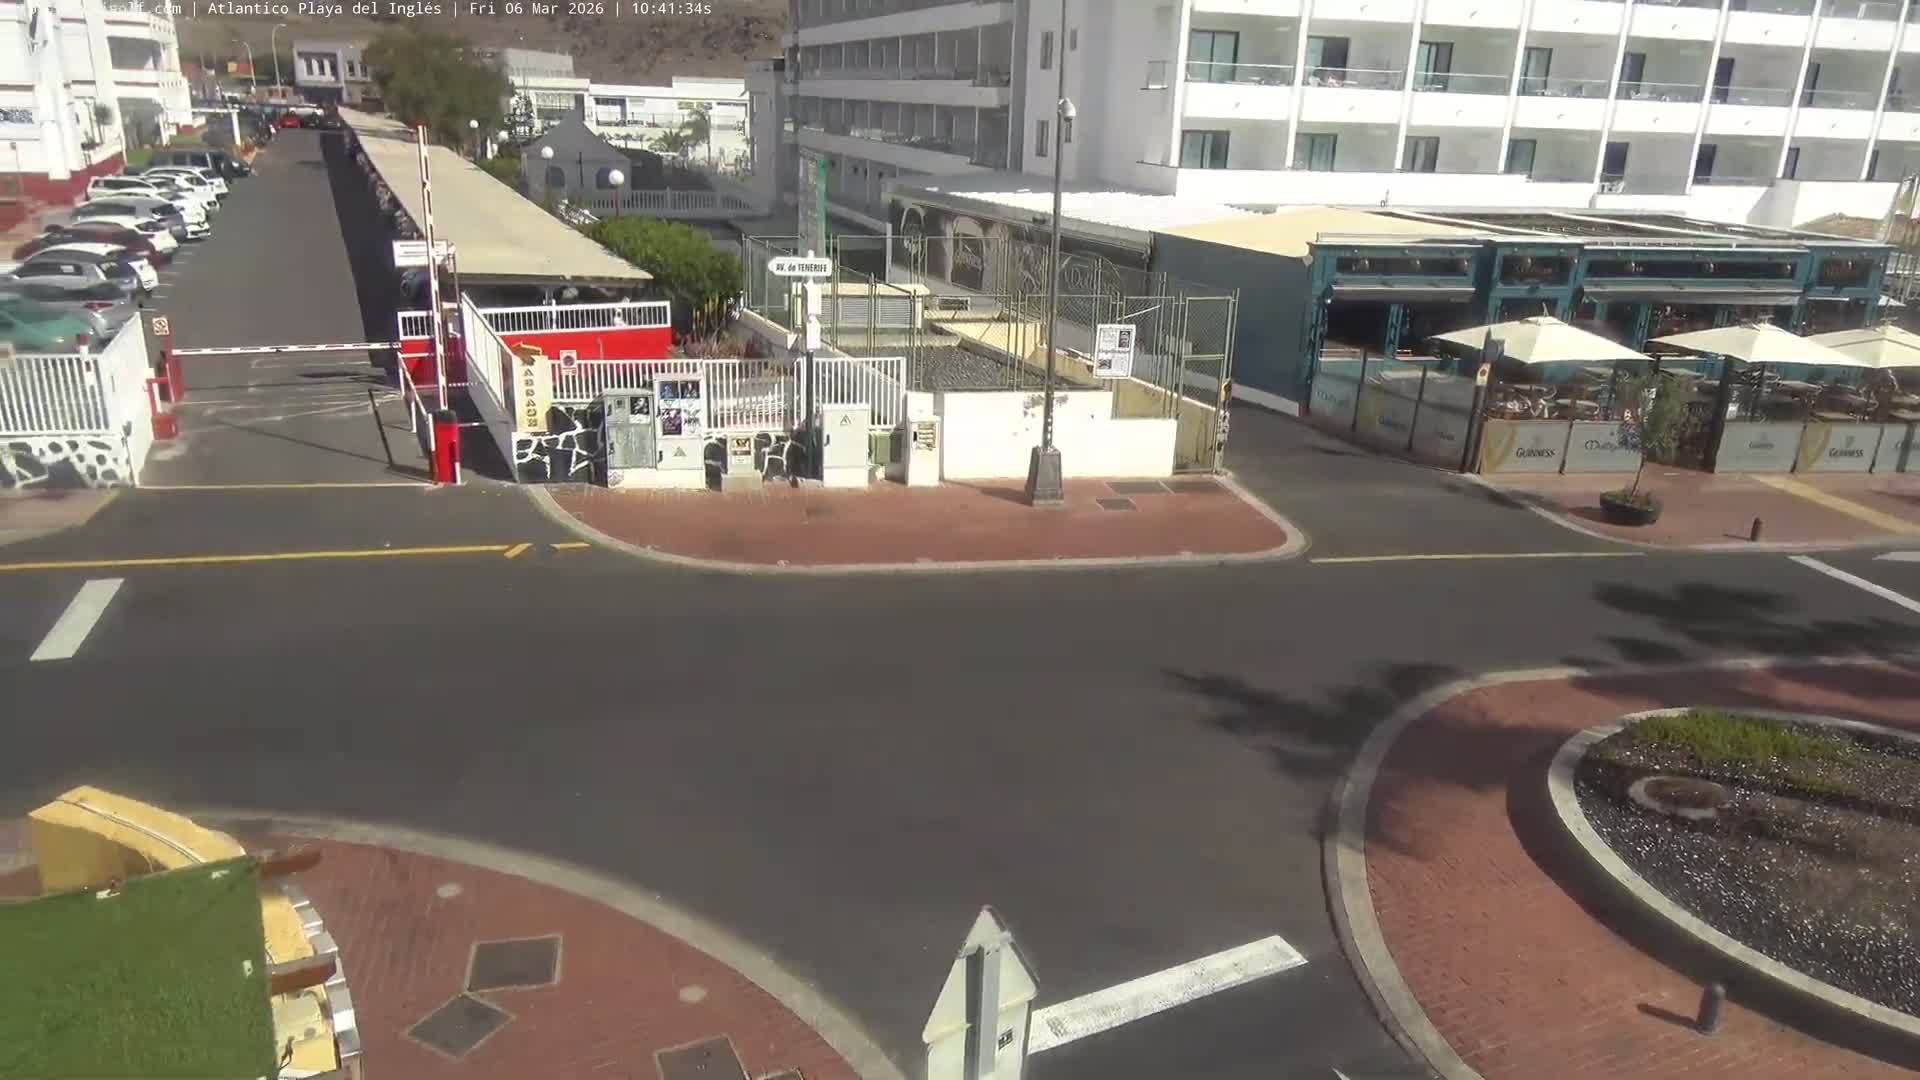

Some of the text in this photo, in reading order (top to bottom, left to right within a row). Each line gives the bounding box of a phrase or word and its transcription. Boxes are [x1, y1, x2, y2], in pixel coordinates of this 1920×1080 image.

[776, 263, 786, 271] AV.
[798, 263, 827, 272] TENERIFE
[1516, 447, 1555, 458] GUINNESS
[1829, 447, 1864, 458] GUINNESS
